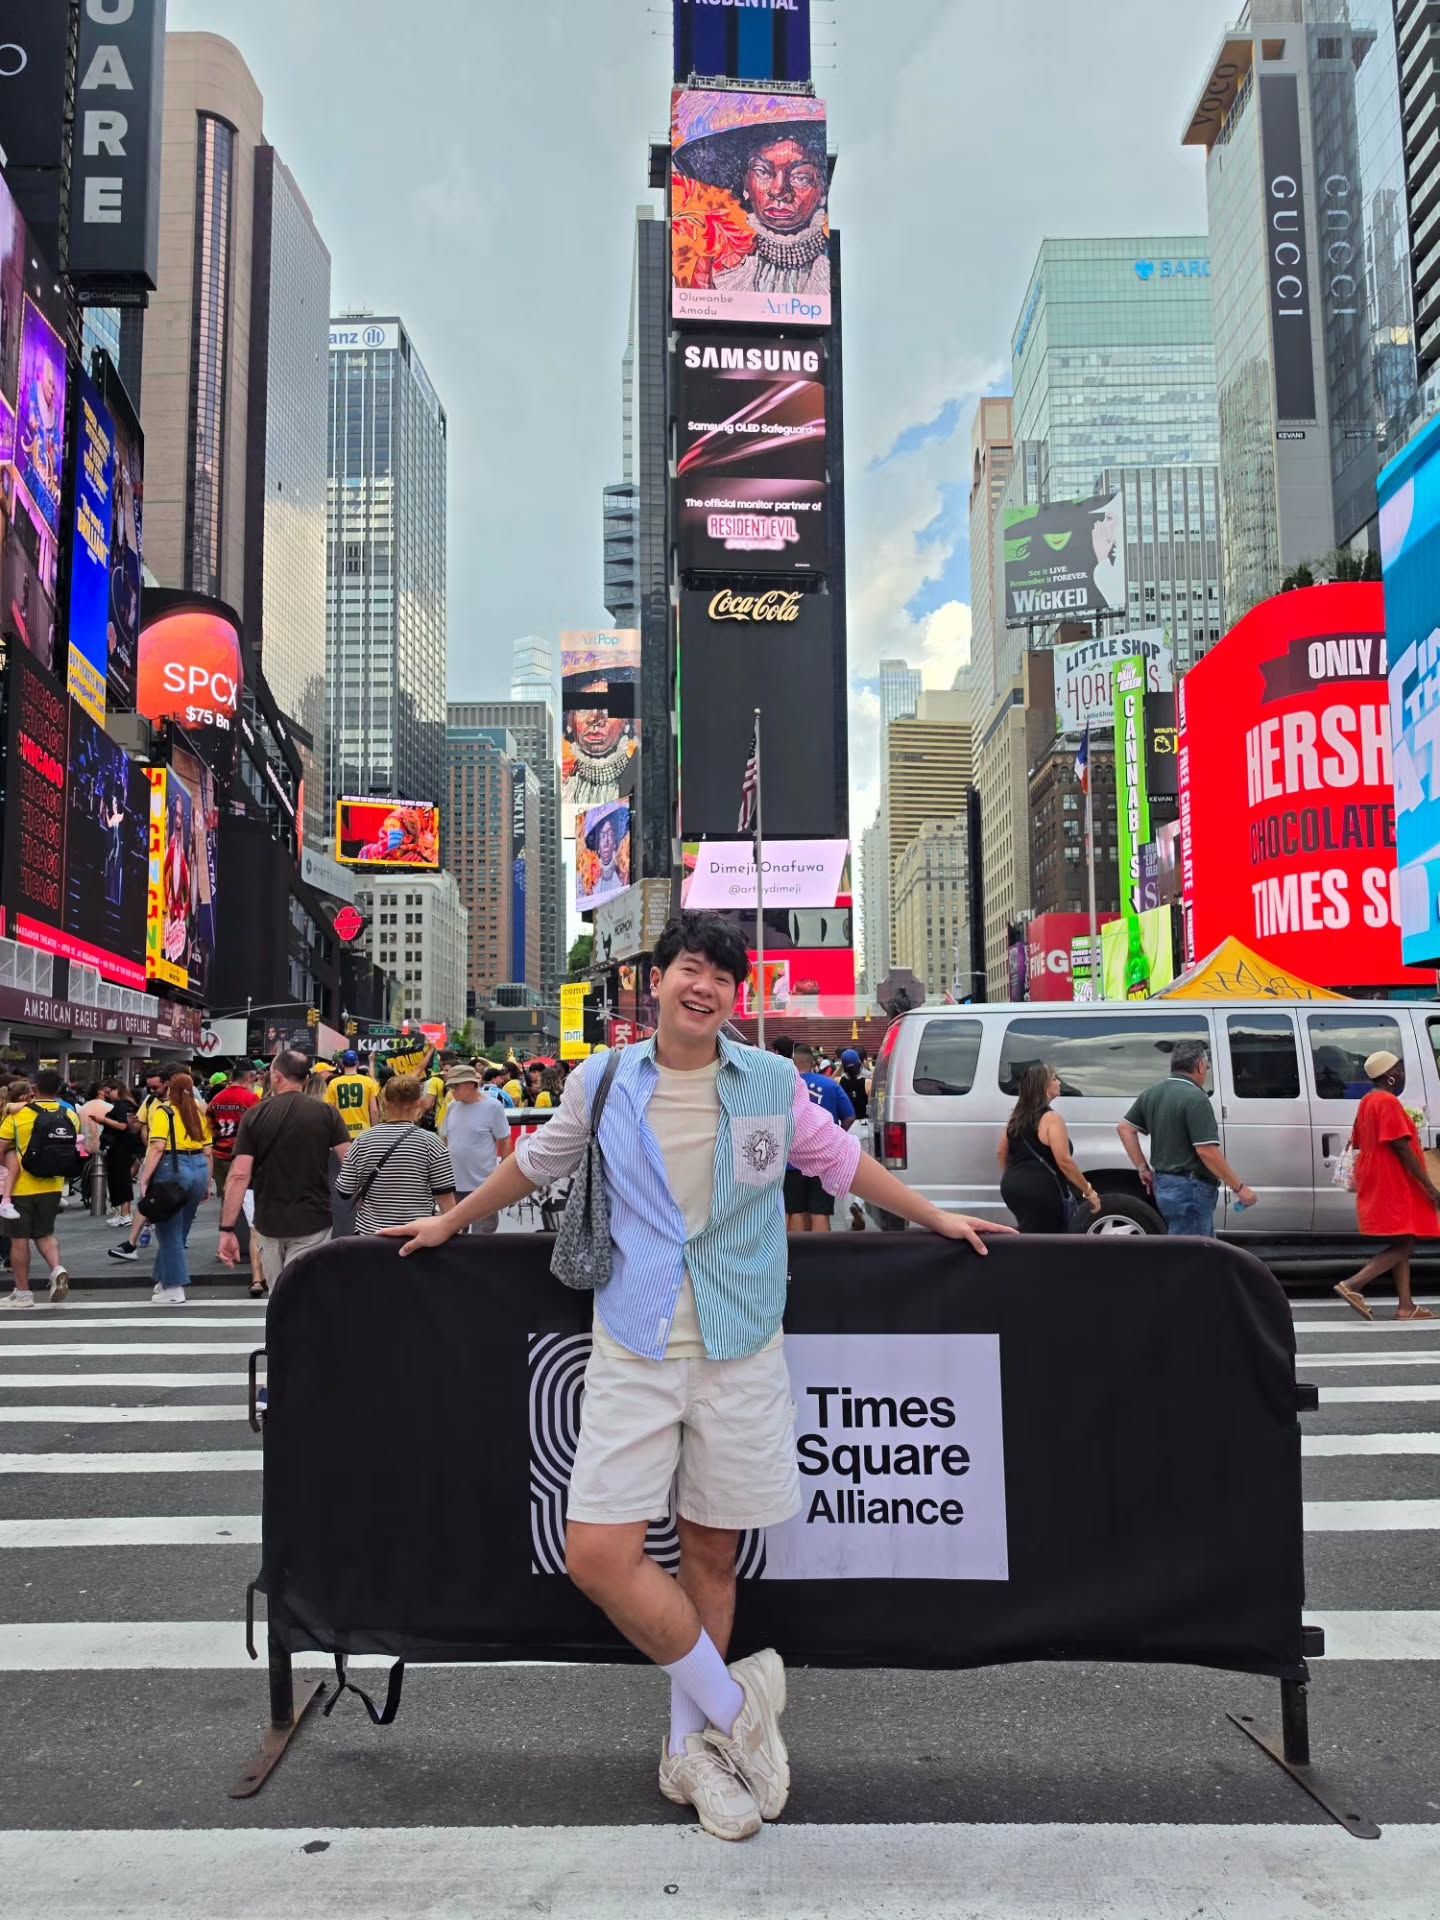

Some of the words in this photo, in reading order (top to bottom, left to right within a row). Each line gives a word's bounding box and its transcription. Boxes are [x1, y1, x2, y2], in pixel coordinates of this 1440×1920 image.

[1271, 175, 1304, 316] GUCCI
[679, 292, 734, 304] Oluwanbe
[679, 306, 718, 316] Amodu
[762, 297, 822, 319] ArtPop
[684, 345, 819, 372] SAMSUNG
[687, 421, 734, 434] Samsung
[735, 423, 760, 433] OLED
[685, 498, 703, 507] The
[704, 498, 736, 508] official
[737, 499, 773, 510] monitor
[774, 501, 810, 512] partner
[812, 502, 822, 511] of
[710, 517, 766, 536] RESIDENT
[770, 518, 796, 538] EVIL
[1066, 640, 1117, 673] LITTLE
[1121, 639, 1160, 660] SHOP
[1308, 638, 1371, 680] ONLY
[163, 662, 238, 711] SPCX
[1066, 664, 1160, 721] HORS
[186, 705, 213, 726] $75
[215, 713, 229, 731] Bn
[1179, 746, 1190, 789] FREE
[1124, 695, 1140, 879] CANNABIS
[1181, 790, 1193, 892] CHOCOLATE
[760, 859, 824, 874] Onafuwa
[728, 880, 801, 896] @artydimeji
[1251, 868, 1350, 939] TIMES
[1030, 951, 1046, 979] FIVE
[24, 997, 71, 1024] AMERICAN
[75, 1008, 97, 1028] EAGLE
[125, 1015, 150, 1035] OFFLINE
[200, 1037, 218, 1052] W
[336, 1082, 363, 1109] 89
[806, 1387, 956, 1428] Times
[796, 1433, 970, 1484] Square
[806, 1489, 964, 1525] Alliance
